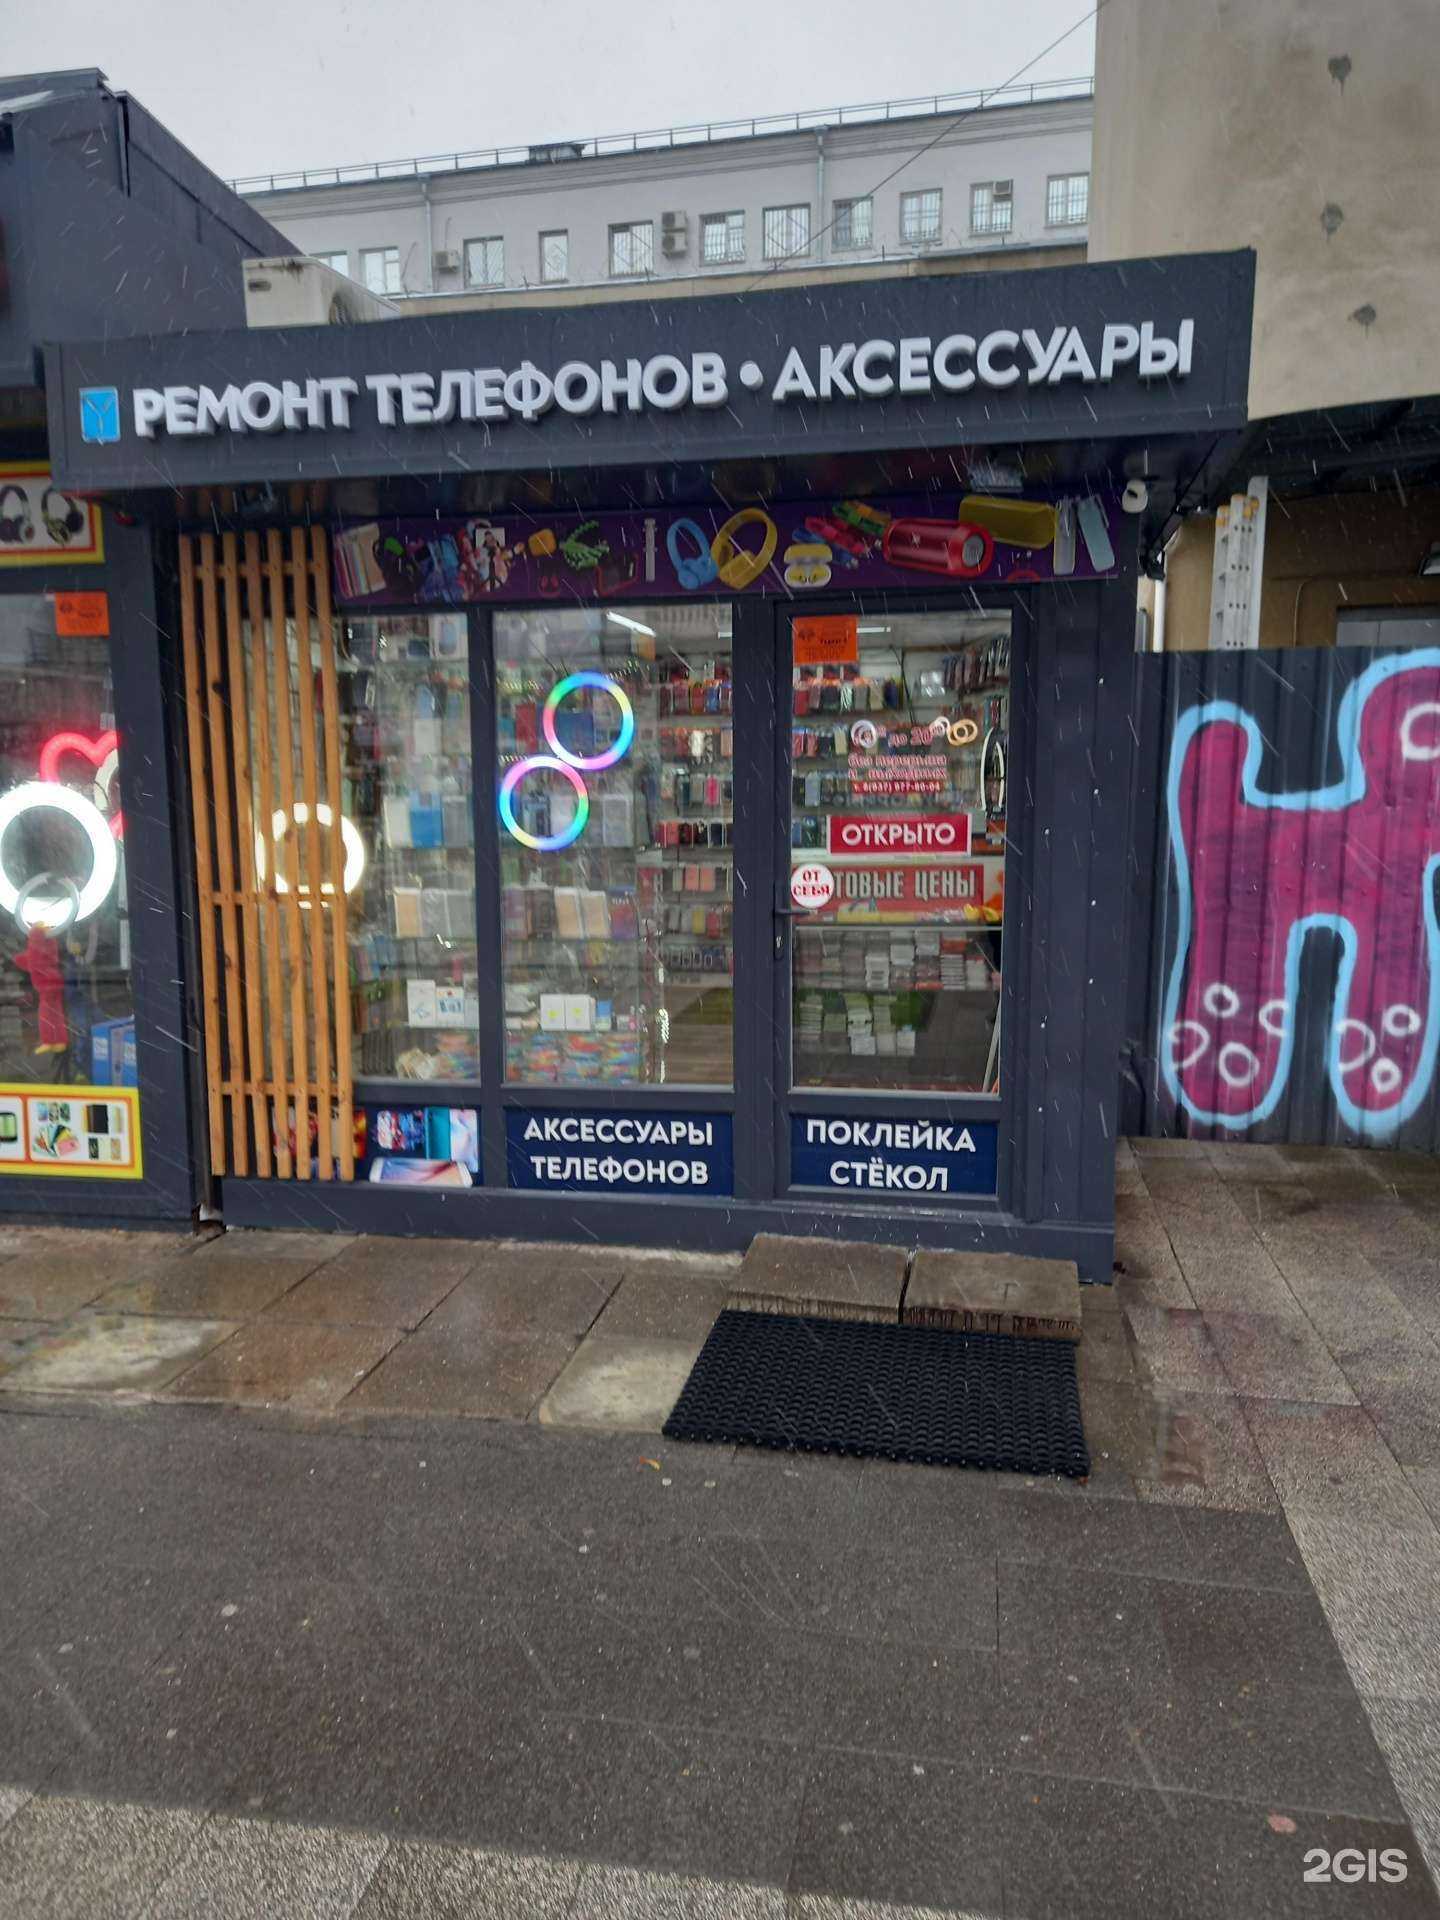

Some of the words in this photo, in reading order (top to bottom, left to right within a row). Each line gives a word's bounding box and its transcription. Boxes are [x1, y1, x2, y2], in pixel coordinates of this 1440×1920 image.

[133, 376, 358, 438] РЕМОНТ
[366, 353, 729, 421] ТЕЛЕФОНОВ
[772, 319, 1195, 401] АКСЕССУАРЫ
[841, 822, 956, 846] ОТКРЫТО
[802, 870, 821, 882] ОТ
[834, 870, 904, 898] ТОВЫЕ
[915, 869, 976, 902] ЦЕНЫ
[523, 1117, 713, 1146] АКСЕССУАРЫ
[806, 1118, 977, 1153] ПОКЛЕЙКА
[530, 1155, 709, 1185] ТЕЛЕФОНОВ
[829, 1156, 948, 1192] СТЁКОЛ
